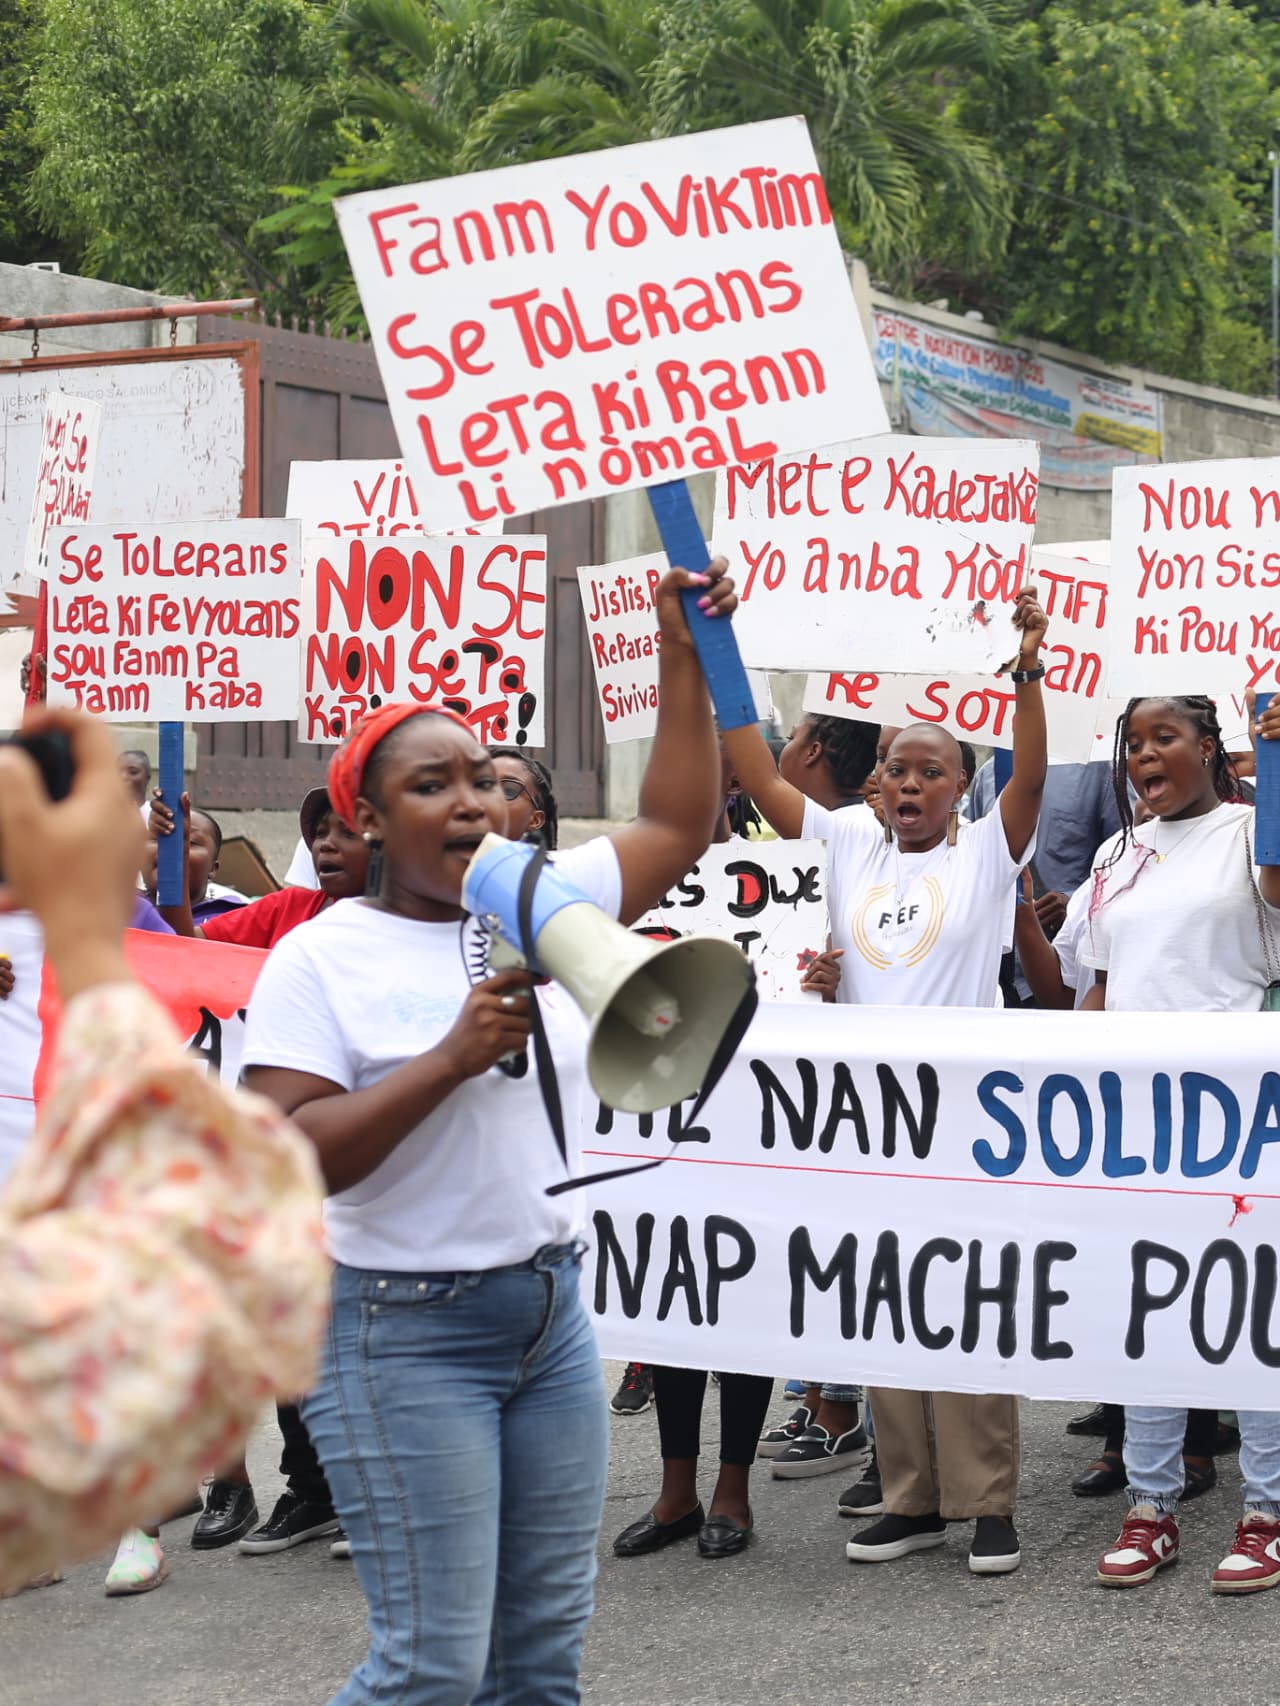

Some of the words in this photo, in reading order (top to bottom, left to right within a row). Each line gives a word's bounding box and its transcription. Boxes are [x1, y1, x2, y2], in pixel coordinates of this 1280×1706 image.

[369, 199, 553, 277] Fanm
[387, 313, 494, 400] Se
[417, 391, 585, 476] LeTa
[593, 371, 651, 434] Ki
[656, 348, 827, 424] Rann
[458, 473, 516, 521] Li
[1139, 479, 1229, 532] Nou
[59, 535, 103, 584] Se
[113, 532, 288, 577] ToLeRans
[740, 540, 786, 602] Yo
[803, 537, 922, 600] anba
[1137, 544, 1204, 599] Yon
[52, 594, 110, 635] LeTa
[117, 594, 142, 636] Ki
[316, 540, 464, 633] NON
[472, 544, 546, 640] SE
[1134, 616, 1168, 654] Ki
[1178, 606, 1238, 656] Pou
[51, 644, 106, 682] Sou
[113, 641, 189, 679] Fanm
[196, 641, 240, 678] Pa
[306, 633, 395, 695] NON
[408, 628, 466, 702] Se
[185, 680, 263, 711] Kaba
[602, 682, 661, 722] Siviva
[906, 681, 1017, 736] SOT
[878, 904, 920, 929] FEF
[750, 1057, 939, 1159] NAN
[593, 1209, 756, 1326] NAP
[788, 1225, 1077, 1361] MACHE
